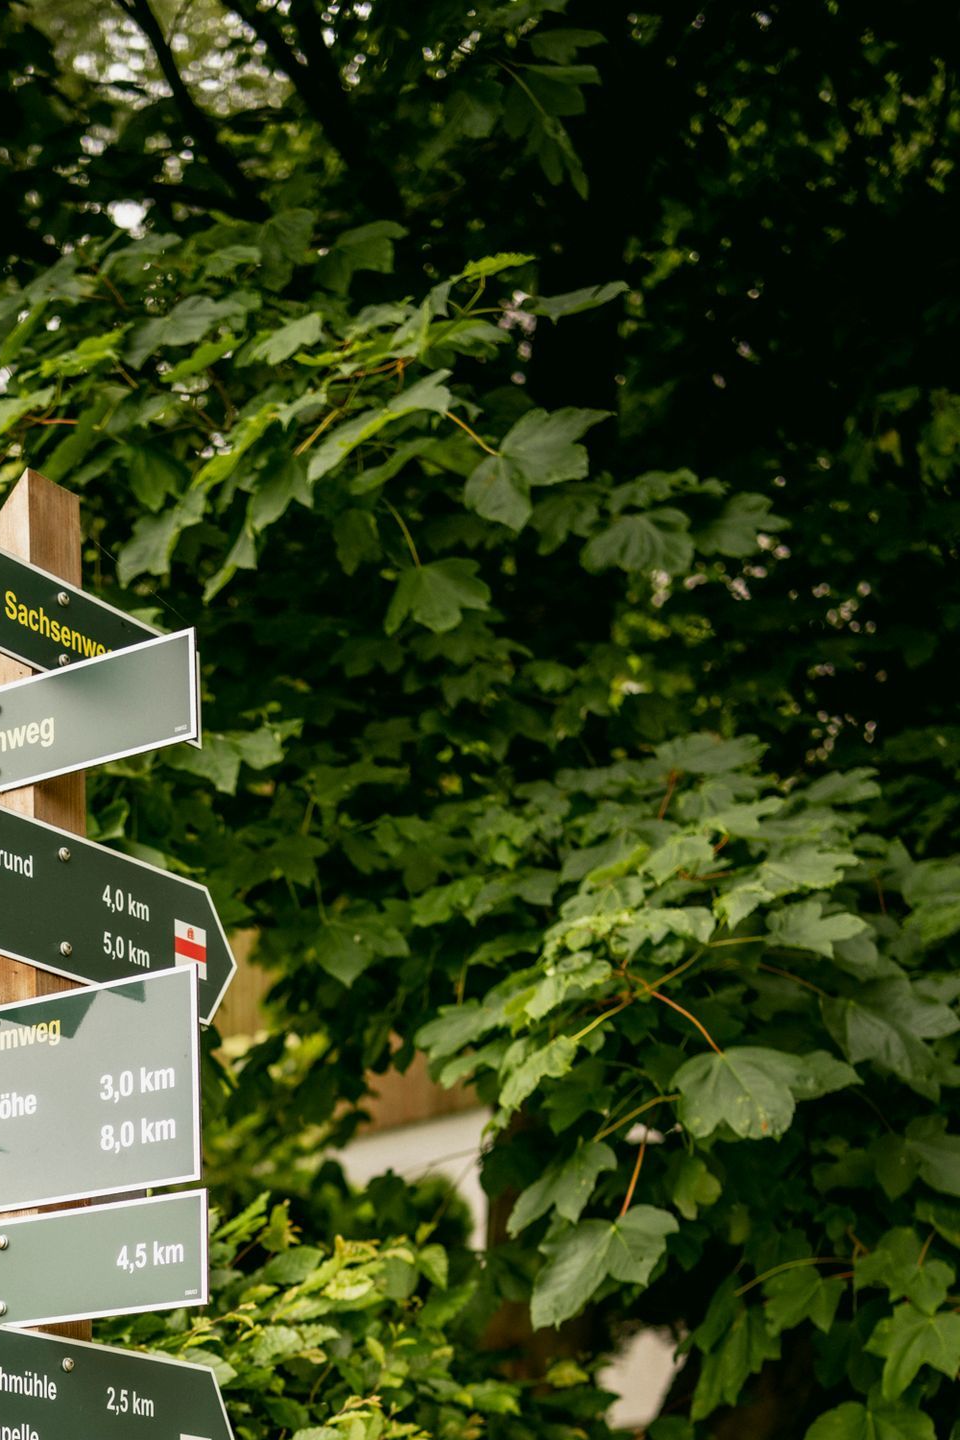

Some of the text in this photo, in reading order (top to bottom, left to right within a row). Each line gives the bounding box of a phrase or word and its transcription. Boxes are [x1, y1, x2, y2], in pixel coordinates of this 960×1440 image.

[4, 590, 113, 658] Sachsenwe
[102, 885, 150, 922] 4,0 km
[103, 931, 150, 968] 5,0 km
[99, 1066, 175, 1104] 3,0 km
[100, 1116, 175, 1154] 8,0 km
[116, 1241, 184, 1273] 4,5 km
[106, 1387, 154, 1417] 2,5 km
